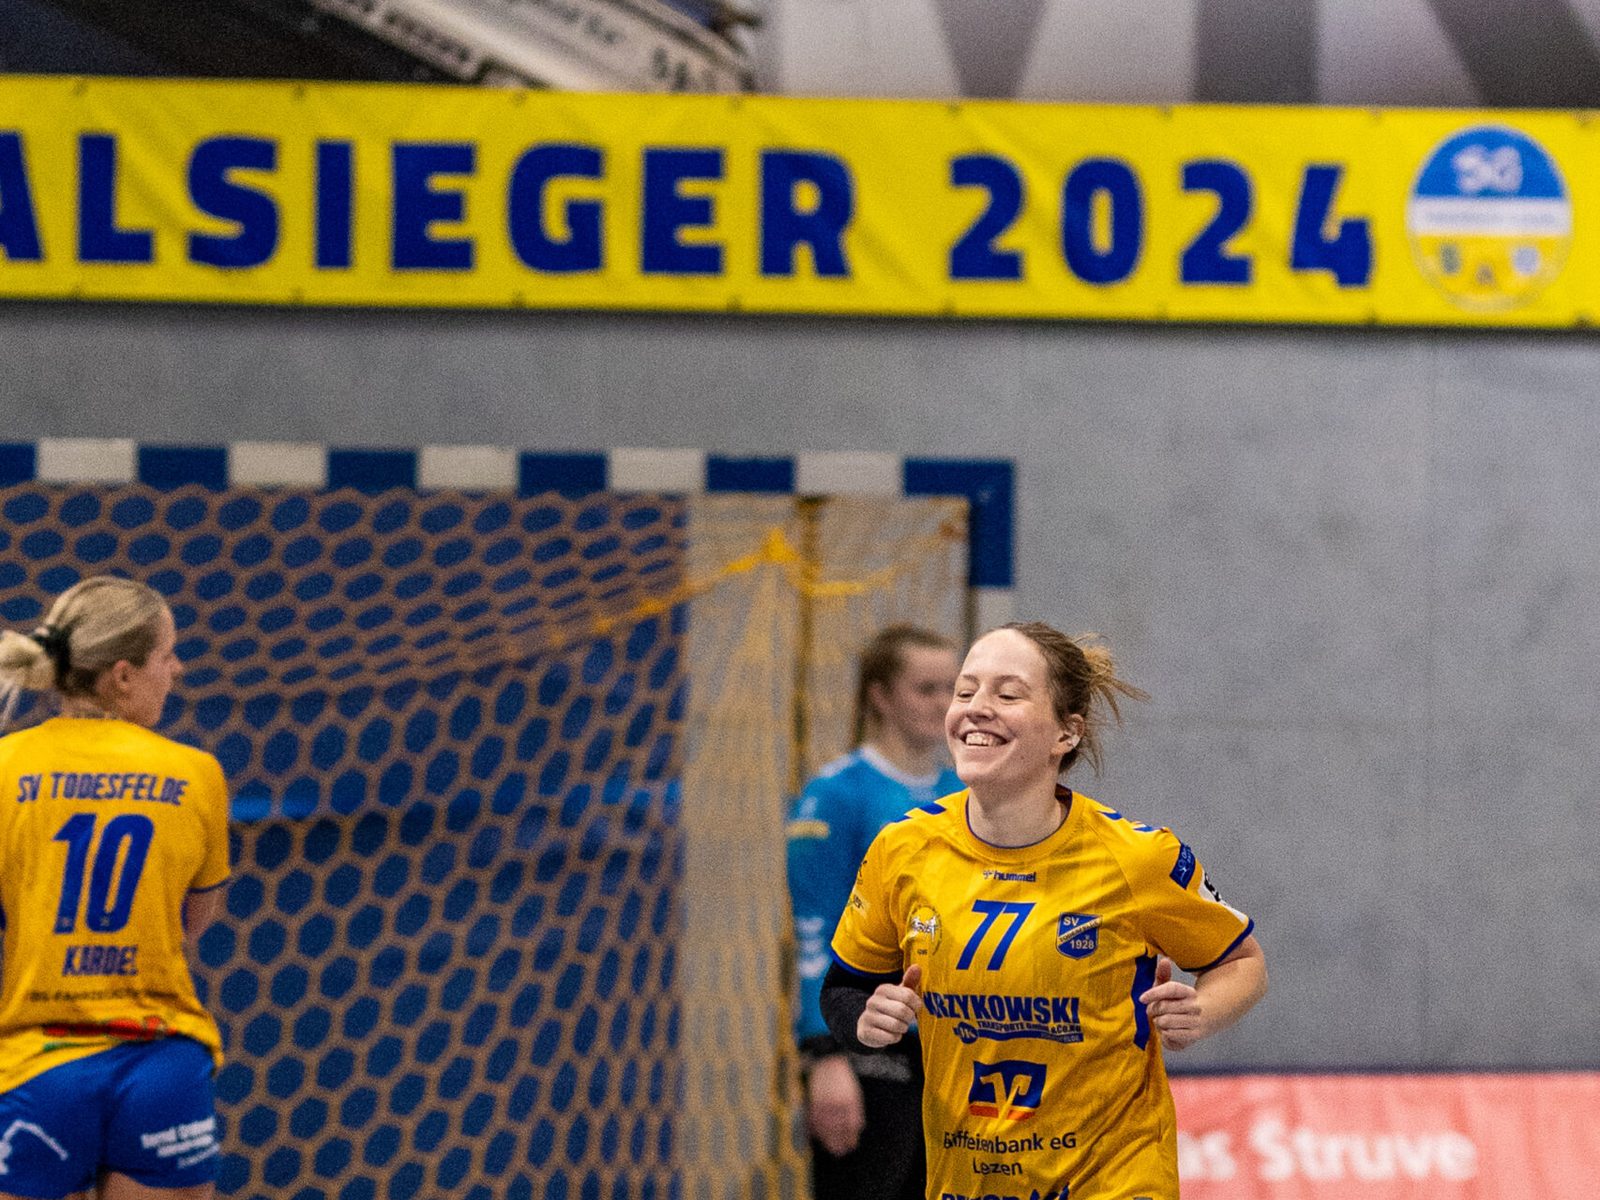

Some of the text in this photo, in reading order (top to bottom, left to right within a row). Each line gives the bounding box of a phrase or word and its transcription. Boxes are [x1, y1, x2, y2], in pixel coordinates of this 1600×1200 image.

[948, 153, 1373, 289] 2024
[17, 771, 190, 806] SV TODESFELDE
[53, 812, 155, 934] 10
[993, 870, 1036, 882] hummel
[956, 899, 1036, 971] 77
[1063, 916, 1080, 927] SV
[1070, 939, 1095, 950] 1928
[1050, 1132, 1077, 1150] eG
[1251, 1114, 1477, 1181] Struve
